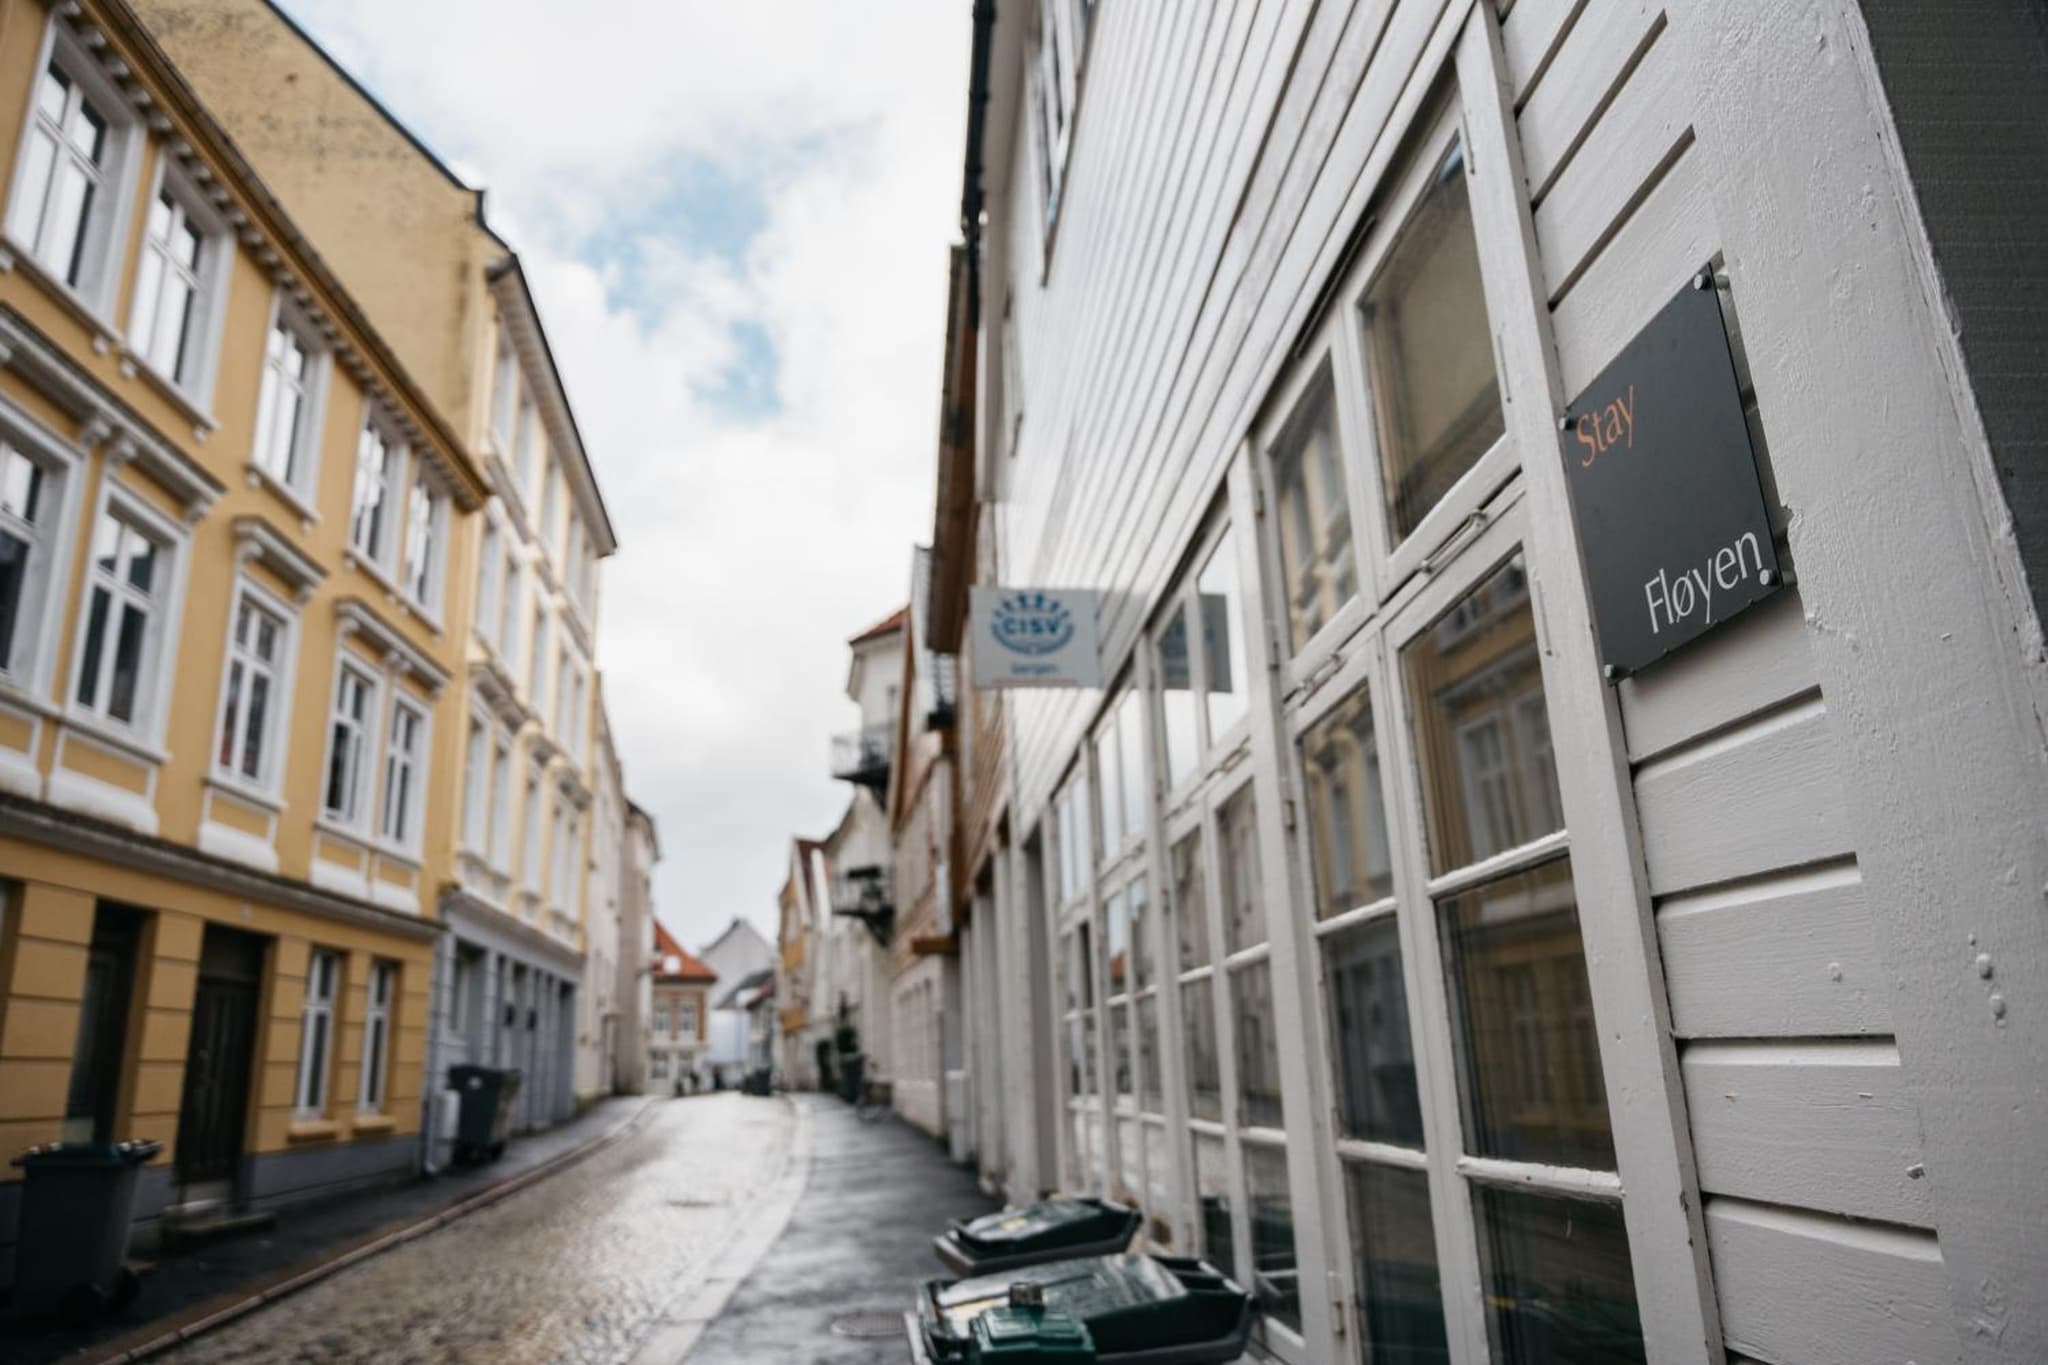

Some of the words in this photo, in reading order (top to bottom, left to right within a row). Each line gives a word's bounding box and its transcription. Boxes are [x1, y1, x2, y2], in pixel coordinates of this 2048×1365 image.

[1576, 385, 1636, 467] Stay
[1644, 531, 1763, 634] Fløyen
[1002, 617, 1060, 634] CISV
